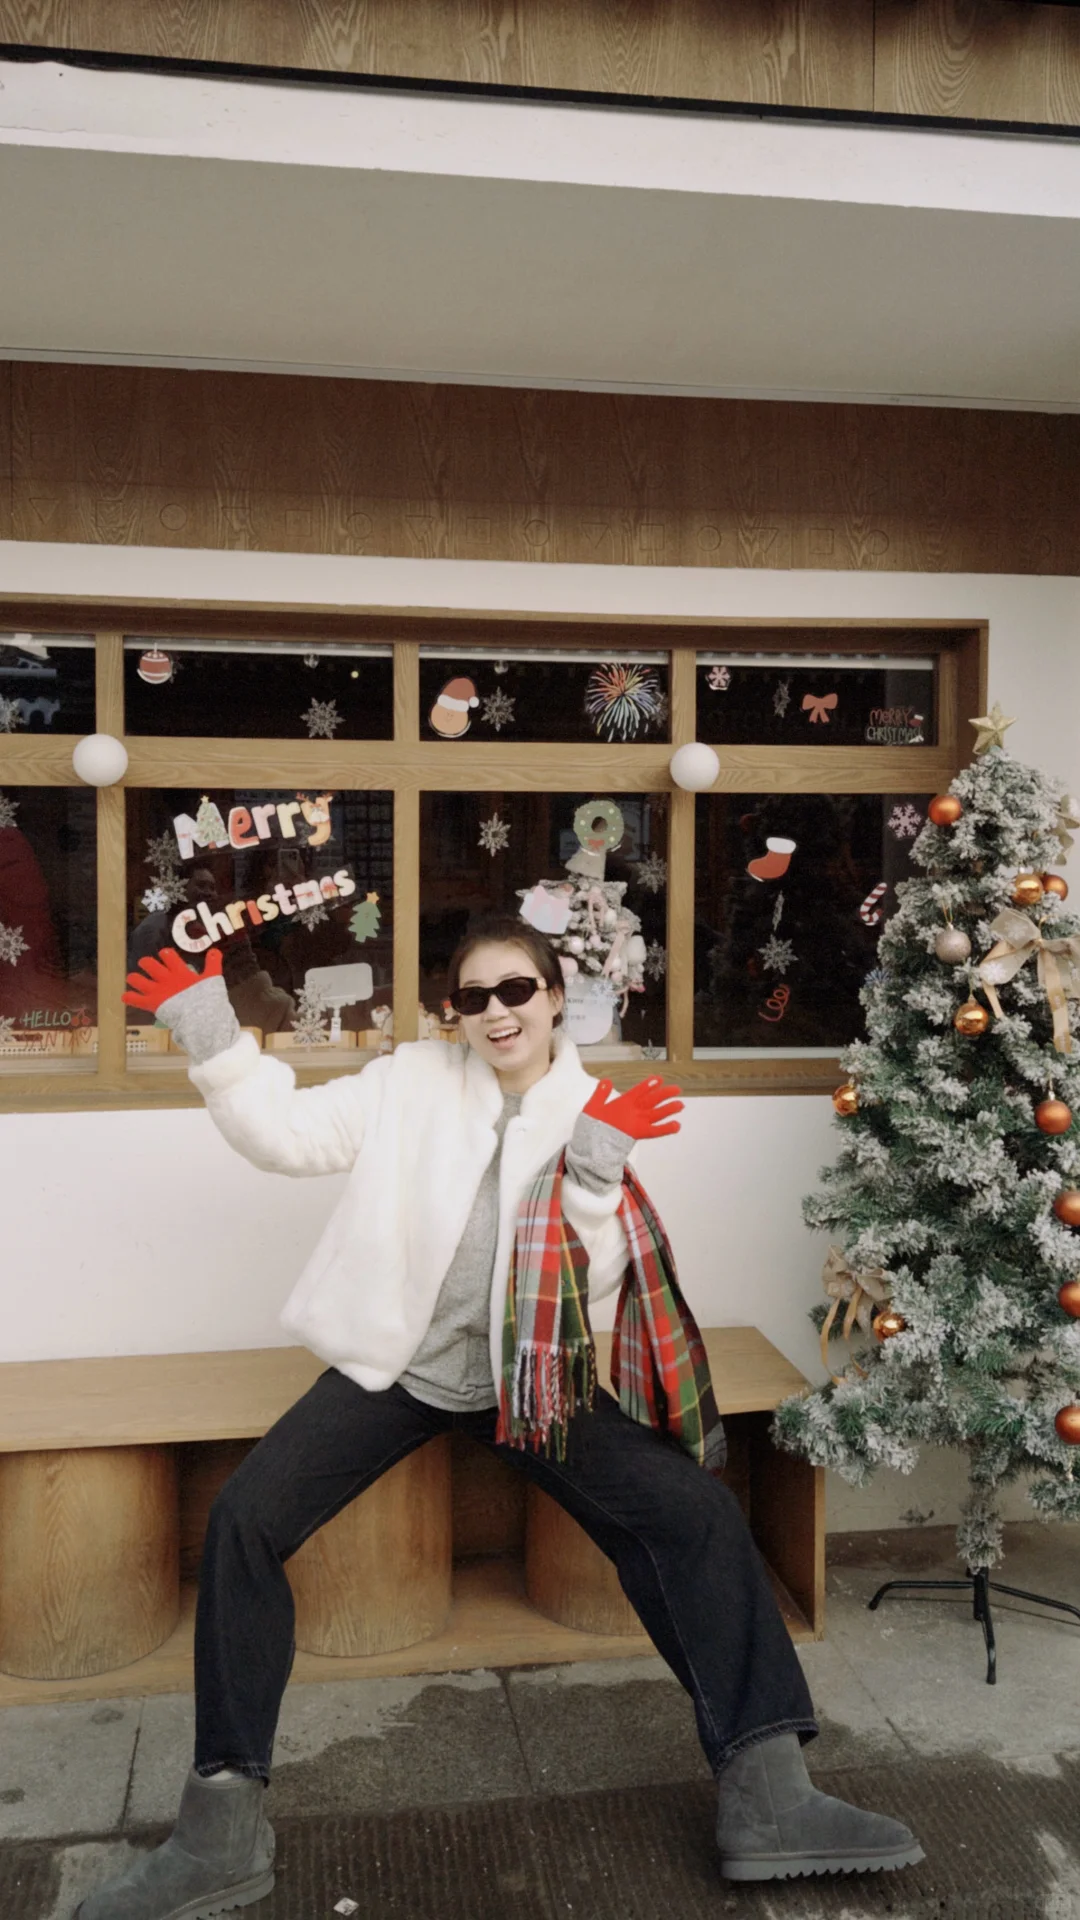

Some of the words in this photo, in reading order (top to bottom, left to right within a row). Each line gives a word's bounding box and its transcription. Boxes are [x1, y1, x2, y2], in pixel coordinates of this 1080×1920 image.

[173, 796, 333, 860] Merry
[171, 869, 356, 953] Christmas
[23, 1010, 72, 1028] HELLO
